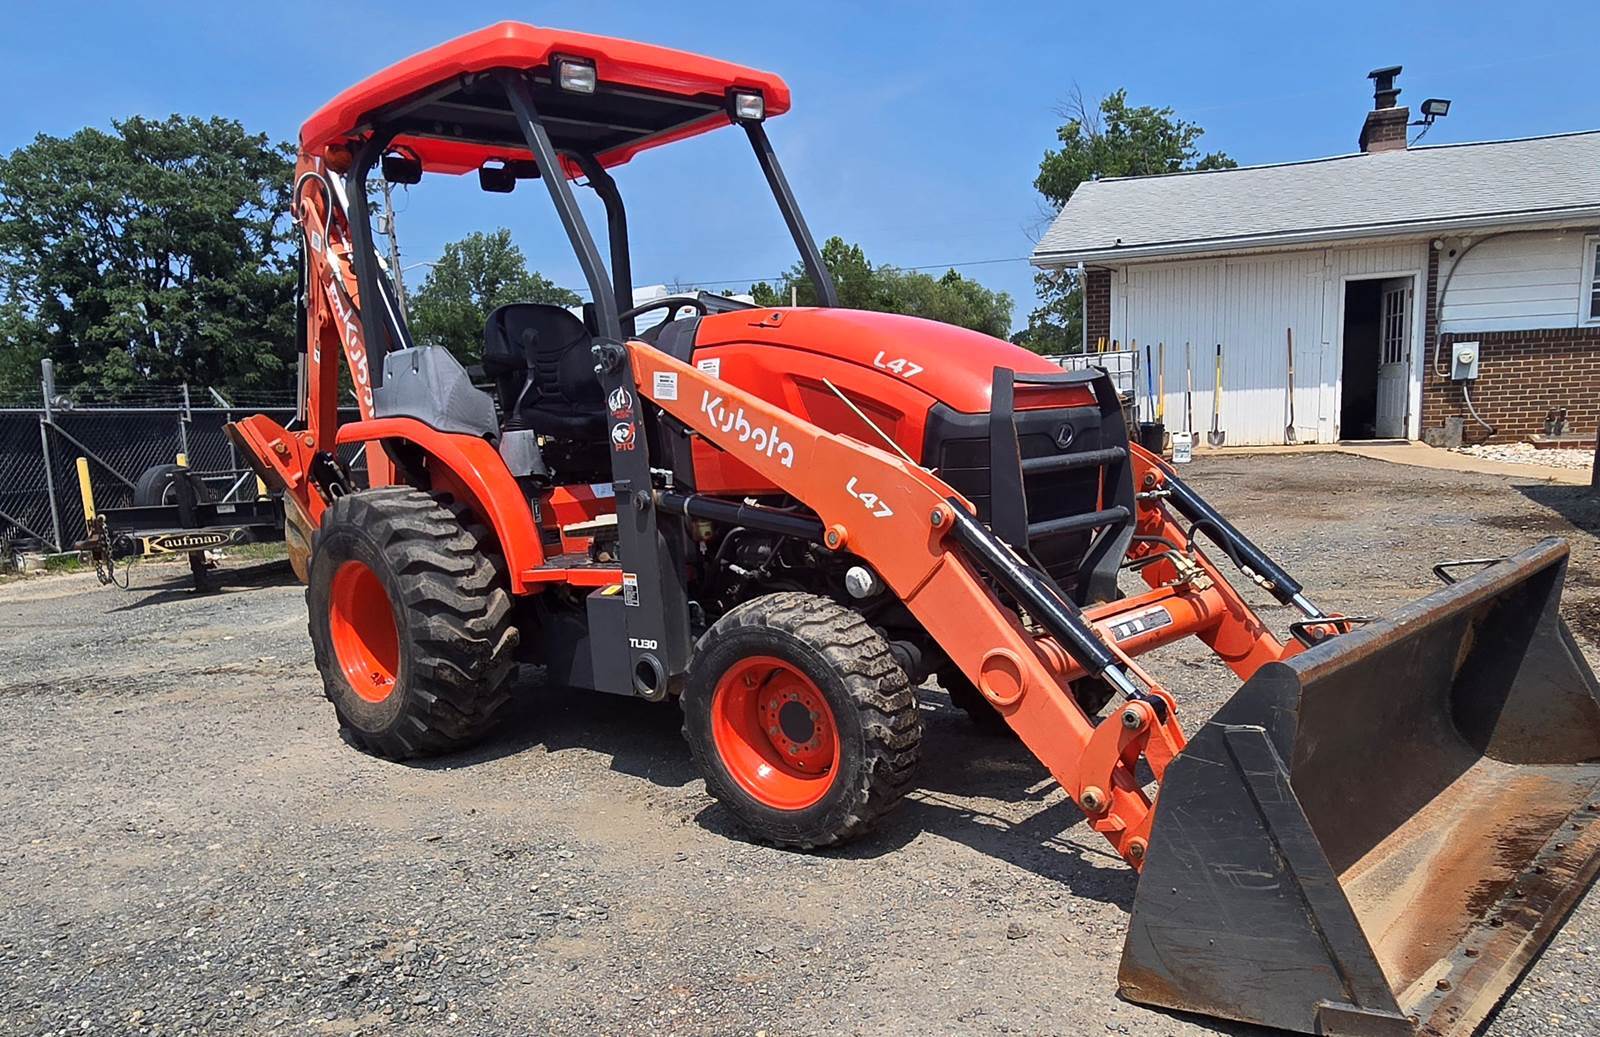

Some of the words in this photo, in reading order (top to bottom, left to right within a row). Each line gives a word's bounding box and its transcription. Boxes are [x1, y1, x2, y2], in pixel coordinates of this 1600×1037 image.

[873, 351, 925, 380] L47
[700, 389, 795, 469] Kubota
[615, 443, 635, 453] PTO
[846, 477, 895, 520] L47
[140, 533, 222, 555] Kaufman
